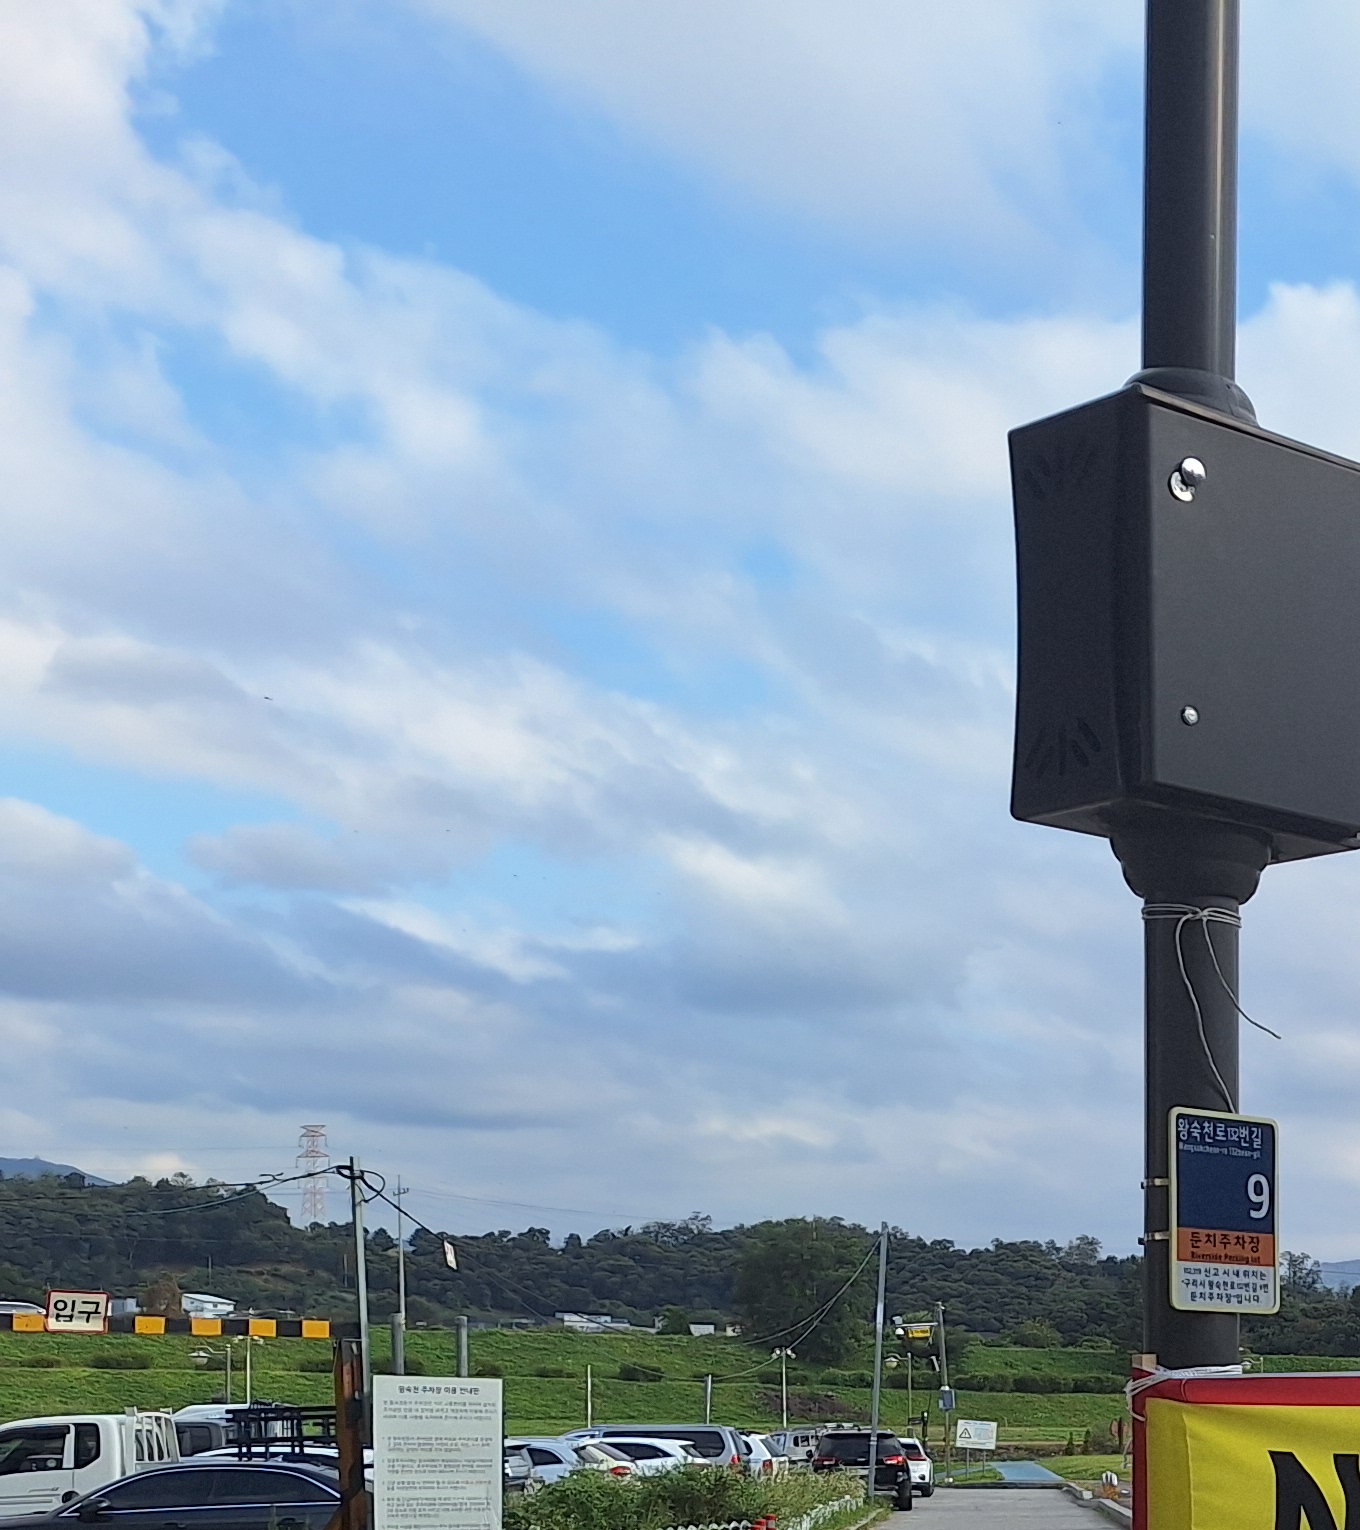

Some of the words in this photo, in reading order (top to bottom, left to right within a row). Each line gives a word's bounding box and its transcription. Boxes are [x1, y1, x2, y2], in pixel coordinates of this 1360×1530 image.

[1247, 1173, 1271, 1219] 9
[1190, 1231, 1260, 1254] 둔치주차장
[53, 1298, 102, 1324] 입구
